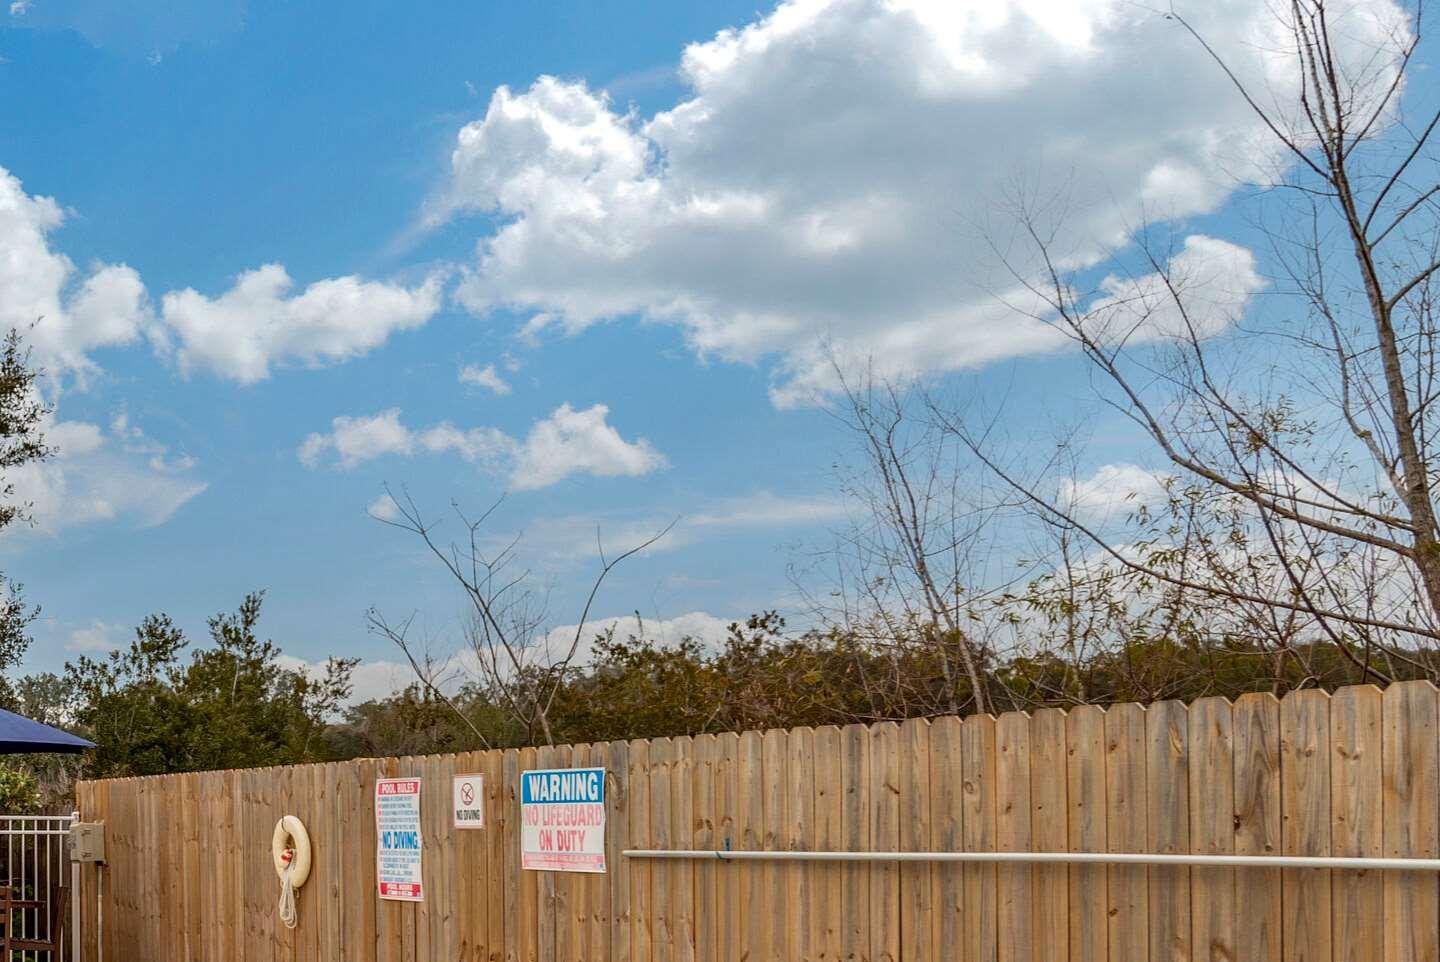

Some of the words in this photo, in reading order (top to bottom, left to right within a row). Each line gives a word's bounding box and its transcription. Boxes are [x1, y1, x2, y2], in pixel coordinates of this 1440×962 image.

[381, 783, 397, 794] POOL
[397, 782, 415, 793] RULES
[528, 772, 599, 801] WARNING
[456, 810, 463, 820] NO
[464, 809, 480, 820] DIVING
[525, 805, 539, 826] NO
[542, 804, 602, 826] LIFEGUARD
[383, 832, 391, 848] NO
[539, 830, 553, 851] ON
[557, 830, 586, 851] DUTY
